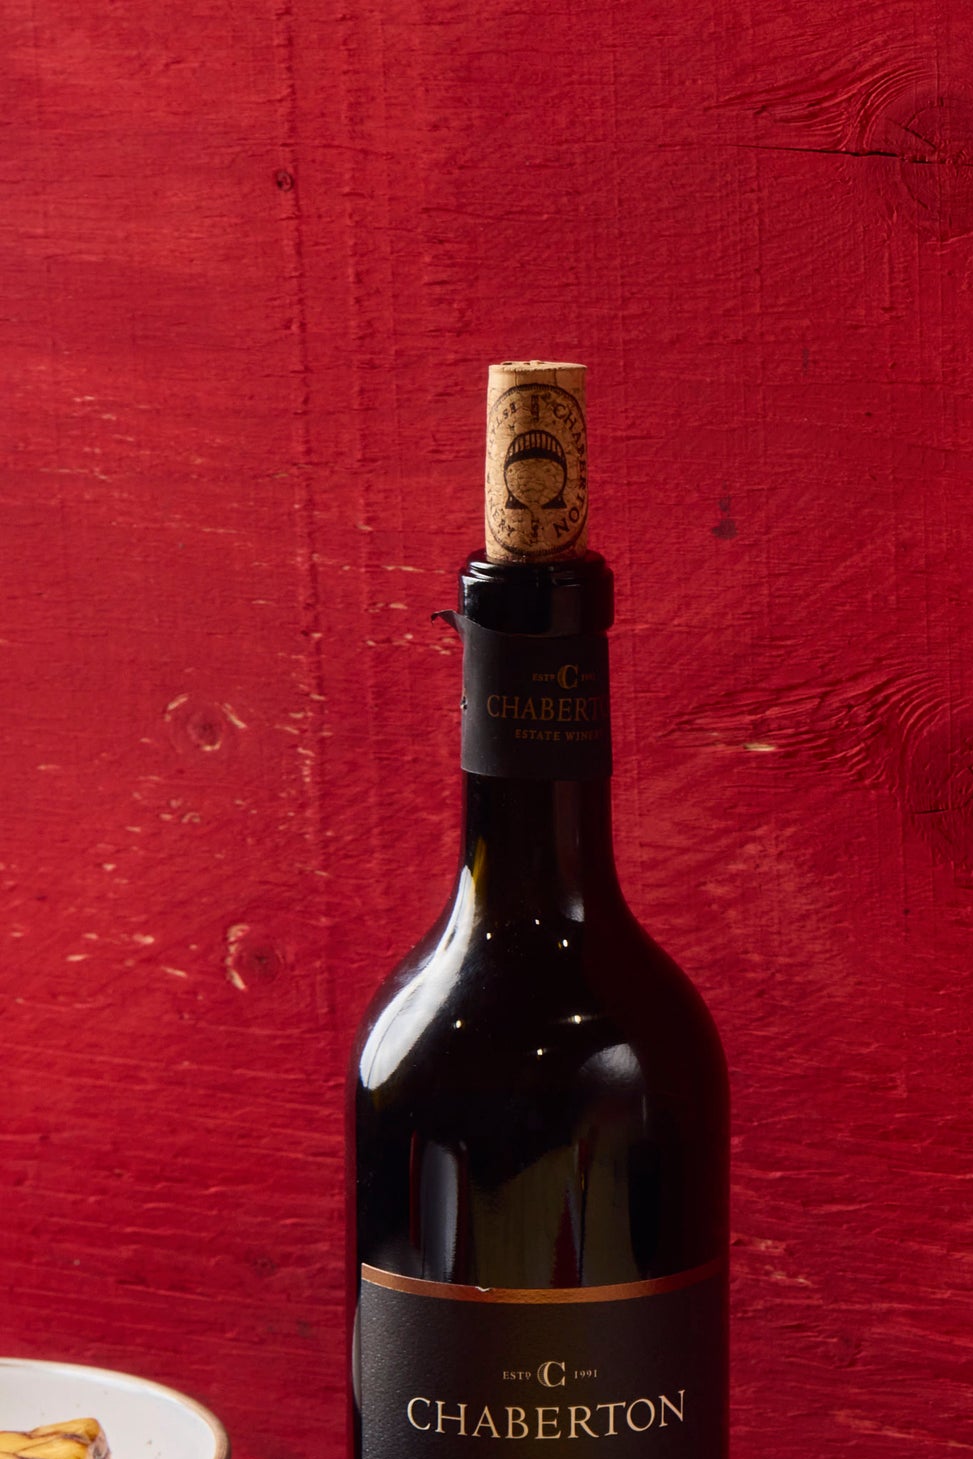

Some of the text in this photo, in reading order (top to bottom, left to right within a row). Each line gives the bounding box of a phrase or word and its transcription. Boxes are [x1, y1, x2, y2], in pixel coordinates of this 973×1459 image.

[514, 728, 561, 742] ESTATE
[536, 1360, 566, 1389] C
[574, 1369, 599, 1380] 1991
[406, 1388, 687, 1440] CHABERTON
